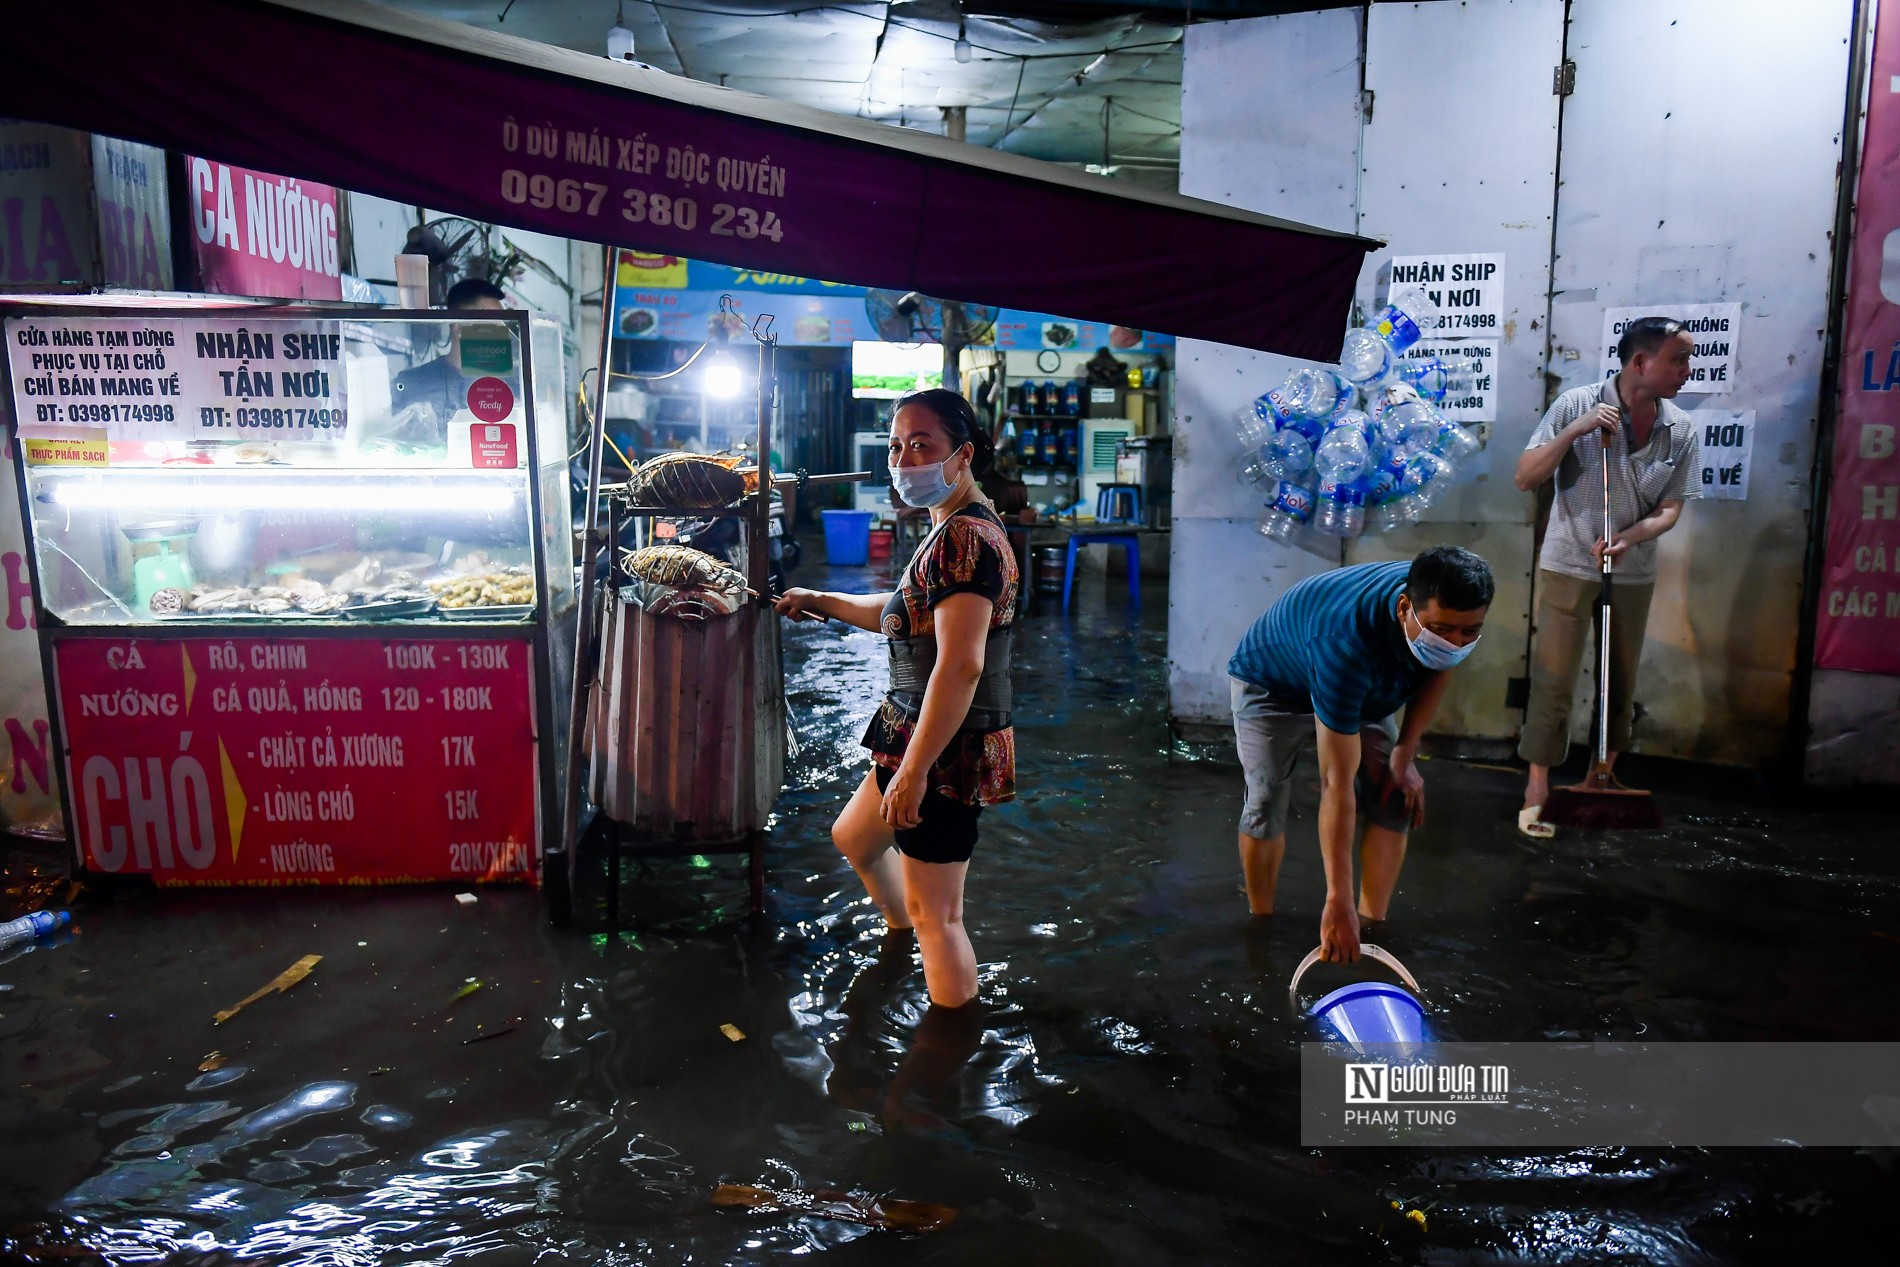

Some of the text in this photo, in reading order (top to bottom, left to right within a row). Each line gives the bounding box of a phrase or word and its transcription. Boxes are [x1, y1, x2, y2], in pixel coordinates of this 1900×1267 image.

[503, 115, 786, 198] Ô DÙ MÁI XẾP ĐỘC QUYỀN
[502, 169, 784, 243] 0967 380 234
[245, 177, 339, 277] NƯỚNG
[101, 199, 166, 290] BIA
[1392, 261, 1496, 286] NHẬN SHIP
[1448, 288, 1481, 307] NƠI
[18, 325, 174, 349] CỬA HÀNG TẠM DỪNG
[1685, 316, 1729, 333] KHÔNG
[196, 327, 274, 364] NHẬN
[32, 348, 165, 373] PHỤC VỤ TẠI CHỖ
[1710, 364, 1727, 381] VỀ
[24, 372, 180, 395] CHỈ BÁN MANG VỀ
[219, 366, 330, 402] TẬN NƠI
[36, 404, 174, 422] ĐT: 0398174998
[201, 407, 232, 428] ĐT:
[478, 400, 502, 413] Foody
[1705, 424, 1744, 447] HƠI
[31, 448, 53, 462] THỰC
[82, 450, 106, 463] SẠCH
[1720, 463, 1743, 485] VỀ
[1855, 540, 1887, 573] CÁ
[1828, 585, 1878, 617] CÁC
[251, 645, 307, 670] CHIM
[384, 646, 436, 669] 100K
[457, 646, 509, 669] 130K
[80, 687, 179, 717] NƯỚNG
[212, 683, 242, 712] CÁ
[304, 678, 362, 711] HỒNG
[381, 687, 420, 711] 120
[440, 687, 493, 711] 180K
[260, 730, 306, 774] CHẶT
[312, 726, 338, 767] CẢ
[342, 734, 404, 767] XƯƠNG
[441, 736, 476, 766] 17K
[83, 731, 216, 872] CHÓ
[264, 784, 313, 821] LÒNG
[318, 784, 354, 821] CHÓ
[445, 790, 479, 820] 15K
[271, 838, 335, 873] NƯỚNG
[449, 835, 528, 873] 20K/XIÊN
